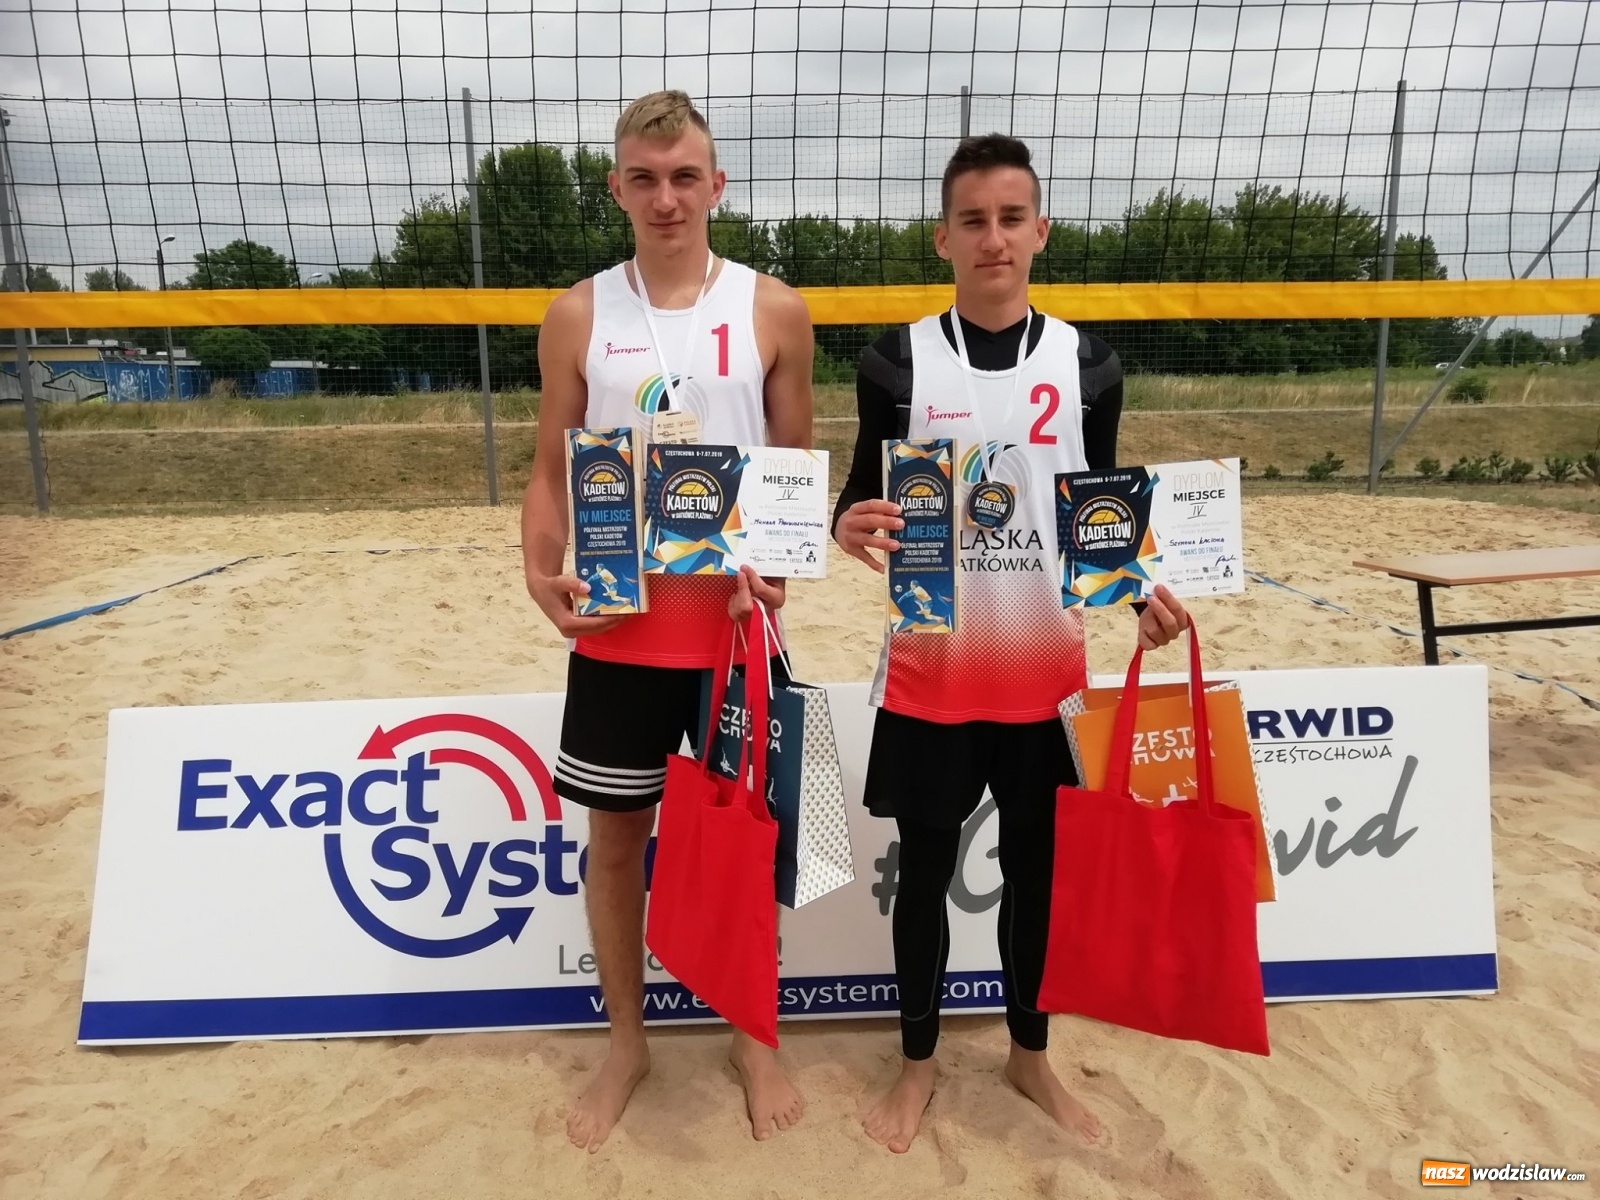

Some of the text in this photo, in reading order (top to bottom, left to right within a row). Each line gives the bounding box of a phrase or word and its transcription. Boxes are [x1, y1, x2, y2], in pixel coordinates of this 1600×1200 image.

[711, 323, 729, 376] 1
[1029, 383, 1060, 445] 2
[764, 457, 813, 476] DYPLOM
[583, 480, 626, 497] KADETÓW
[763, 475, 814, 487] MIEJSCE
[1173, 471, 1225, 492] DYPLOM
[667, 493, 719, 513] KADETÓW
[900, 494, 943, 510] KADETÓW
[974, 496, 1008, 514] KADETÓW
[1173, 489, 1226, 502] MIEJSCE
[580, 509, 632, 523] IV MIEJSCE
[907, 525, 949, 539] MIEJSCE
[1079, 521, 1132, 543] KADETÓW
[960, 529, 1044, 556] LĄSKA
[960, 554, 1044, 572] ATKÓWKA
[1247, 706, 1394, 739] RWID
[177, 751, 440, 831] Exact
